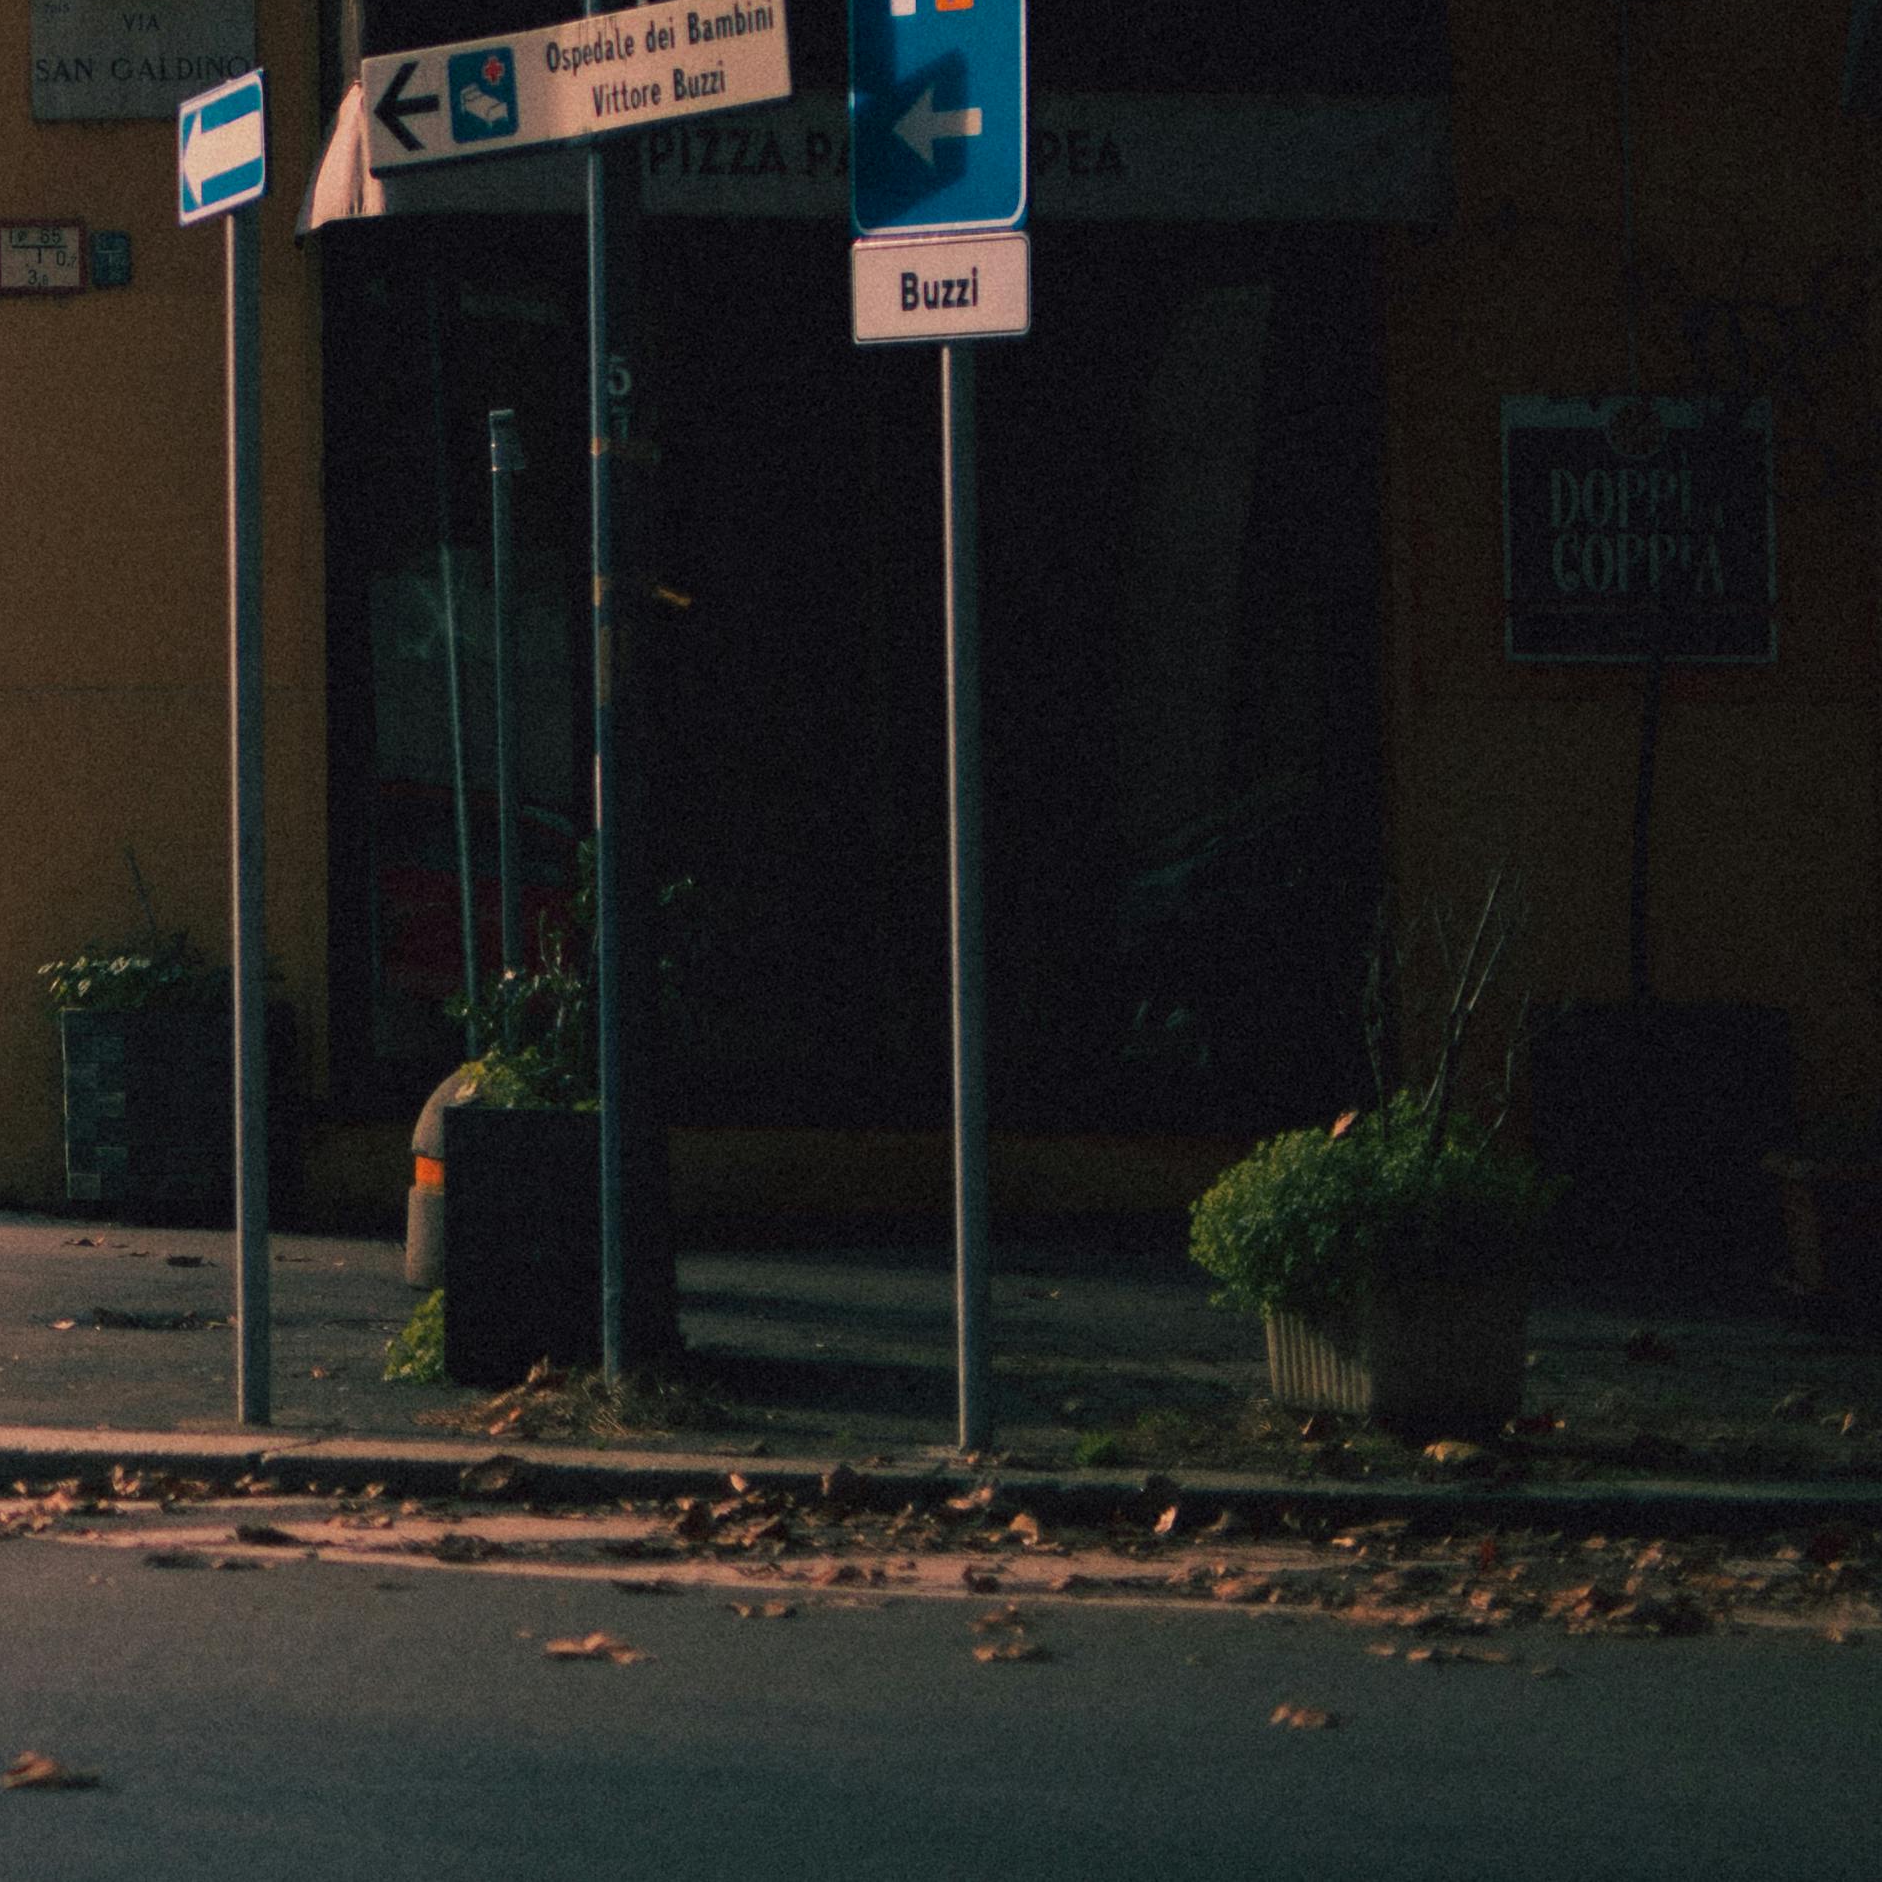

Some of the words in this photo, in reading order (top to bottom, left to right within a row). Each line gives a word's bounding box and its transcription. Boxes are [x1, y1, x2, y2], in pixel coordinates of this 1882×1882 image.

[122, 13, 160, 32] VIA
[37, 57, 93, 83] SAN
[110, 55, 250, 82] GALDINO
[546, 30, 635, 74] Ospedale
[646, 20, 676, 55] dei
[592, 76, 661, 118] Vittore
[673, 61, 726, 101] Buzzi
[647, 127, 787, 178] PIZZA
[900, 267, 980, 313] Buzzi
